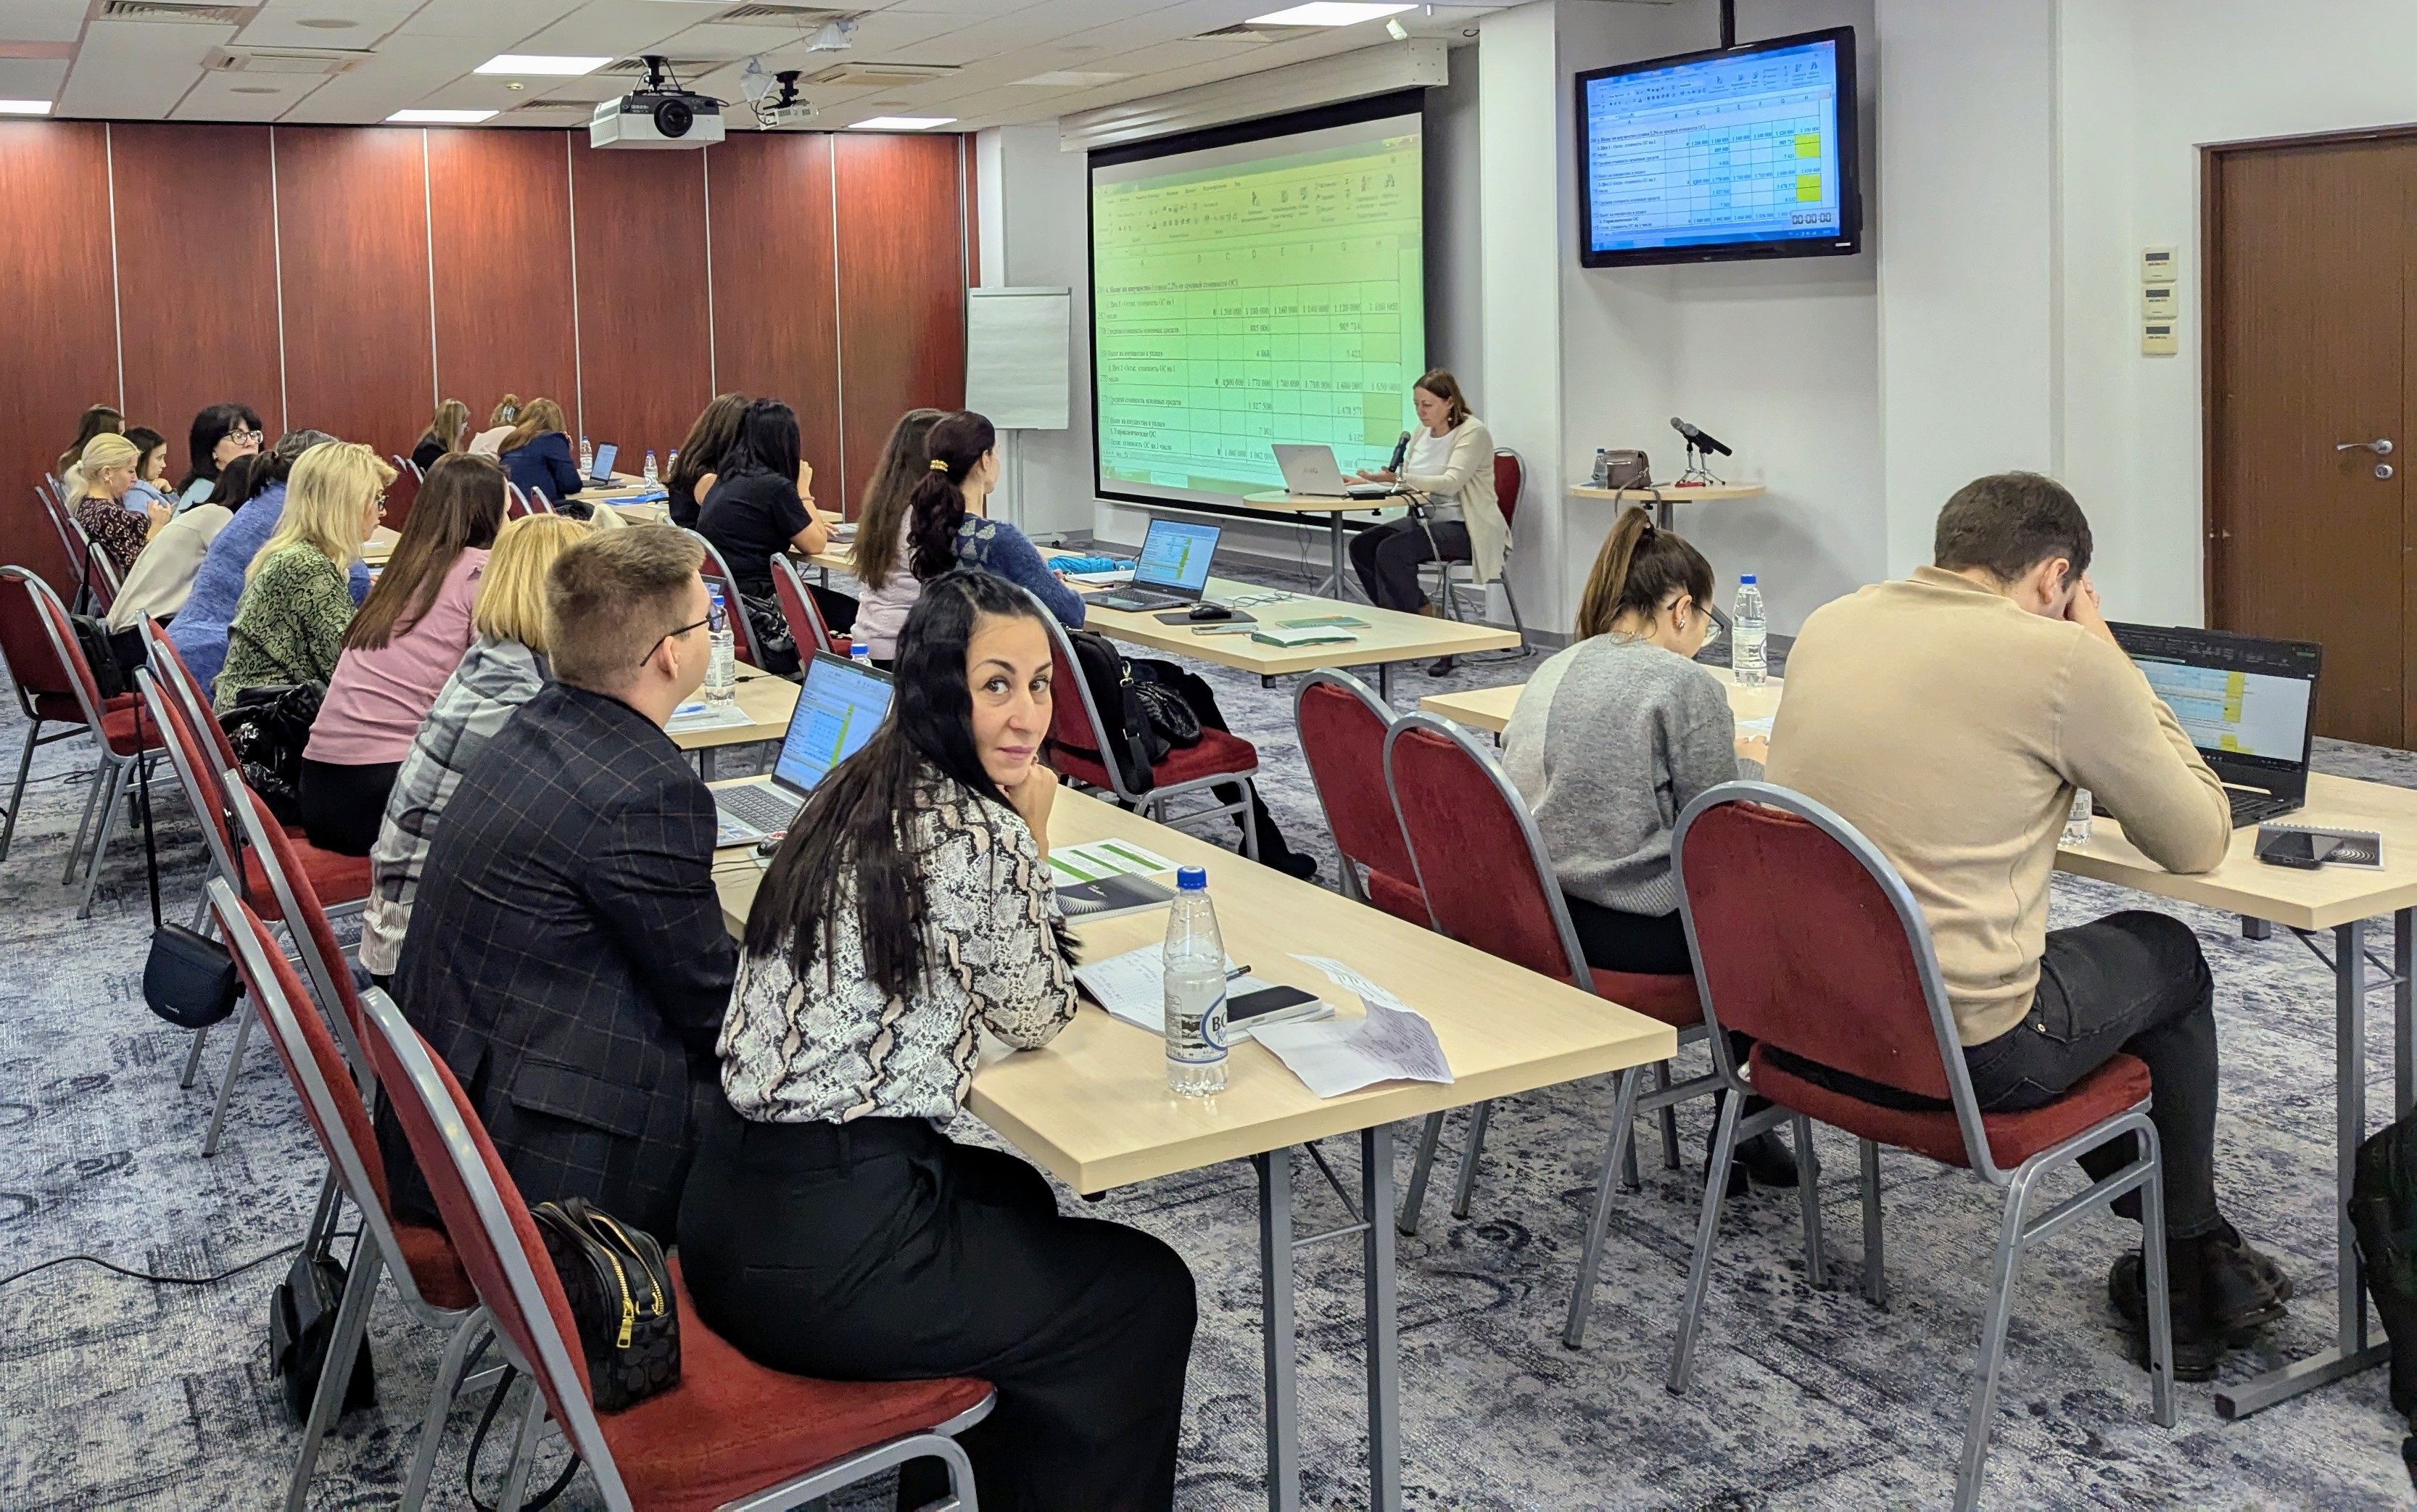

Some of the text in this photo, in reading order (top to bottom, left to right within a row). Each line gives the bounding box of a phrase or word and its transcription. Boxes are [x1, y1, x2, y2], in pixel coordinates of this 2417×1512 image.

[1792, 212, 1832, 225] 00:00:00
[1280, 247, 1285, 257] E
[1310, 244, 1314, 253] F
